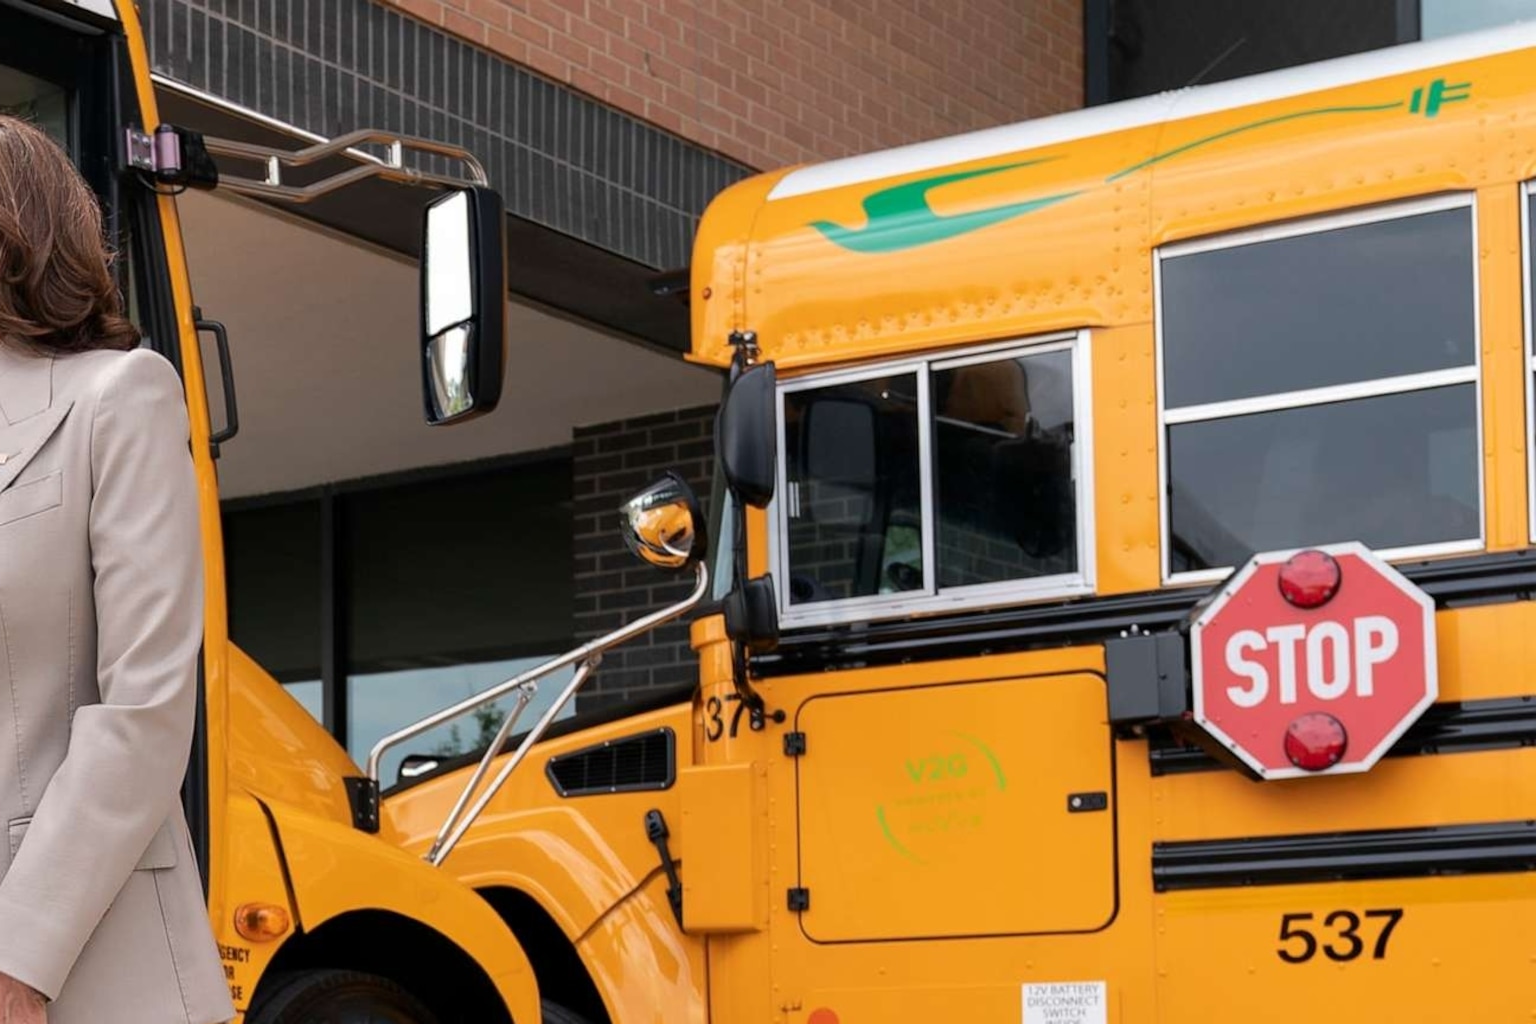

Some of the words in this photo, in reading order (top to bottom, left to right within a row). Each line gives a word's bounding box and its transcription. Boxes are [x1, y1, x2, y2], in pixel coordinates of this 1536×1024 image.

[1225, 615, 1399, 708] STOP
[905, 752, 968, 784] V2G
[1276, 908, 1404, 964] 537
[217, 943, 251, 963] GENCY
[1028, 985, 1048, 996] 12V
[1050, 984, 1100, 995] BATTERY
[1027, 996, 1099, 1008] DISCONNECT
[1043, 1007, 1086, 1019] SWITCH
